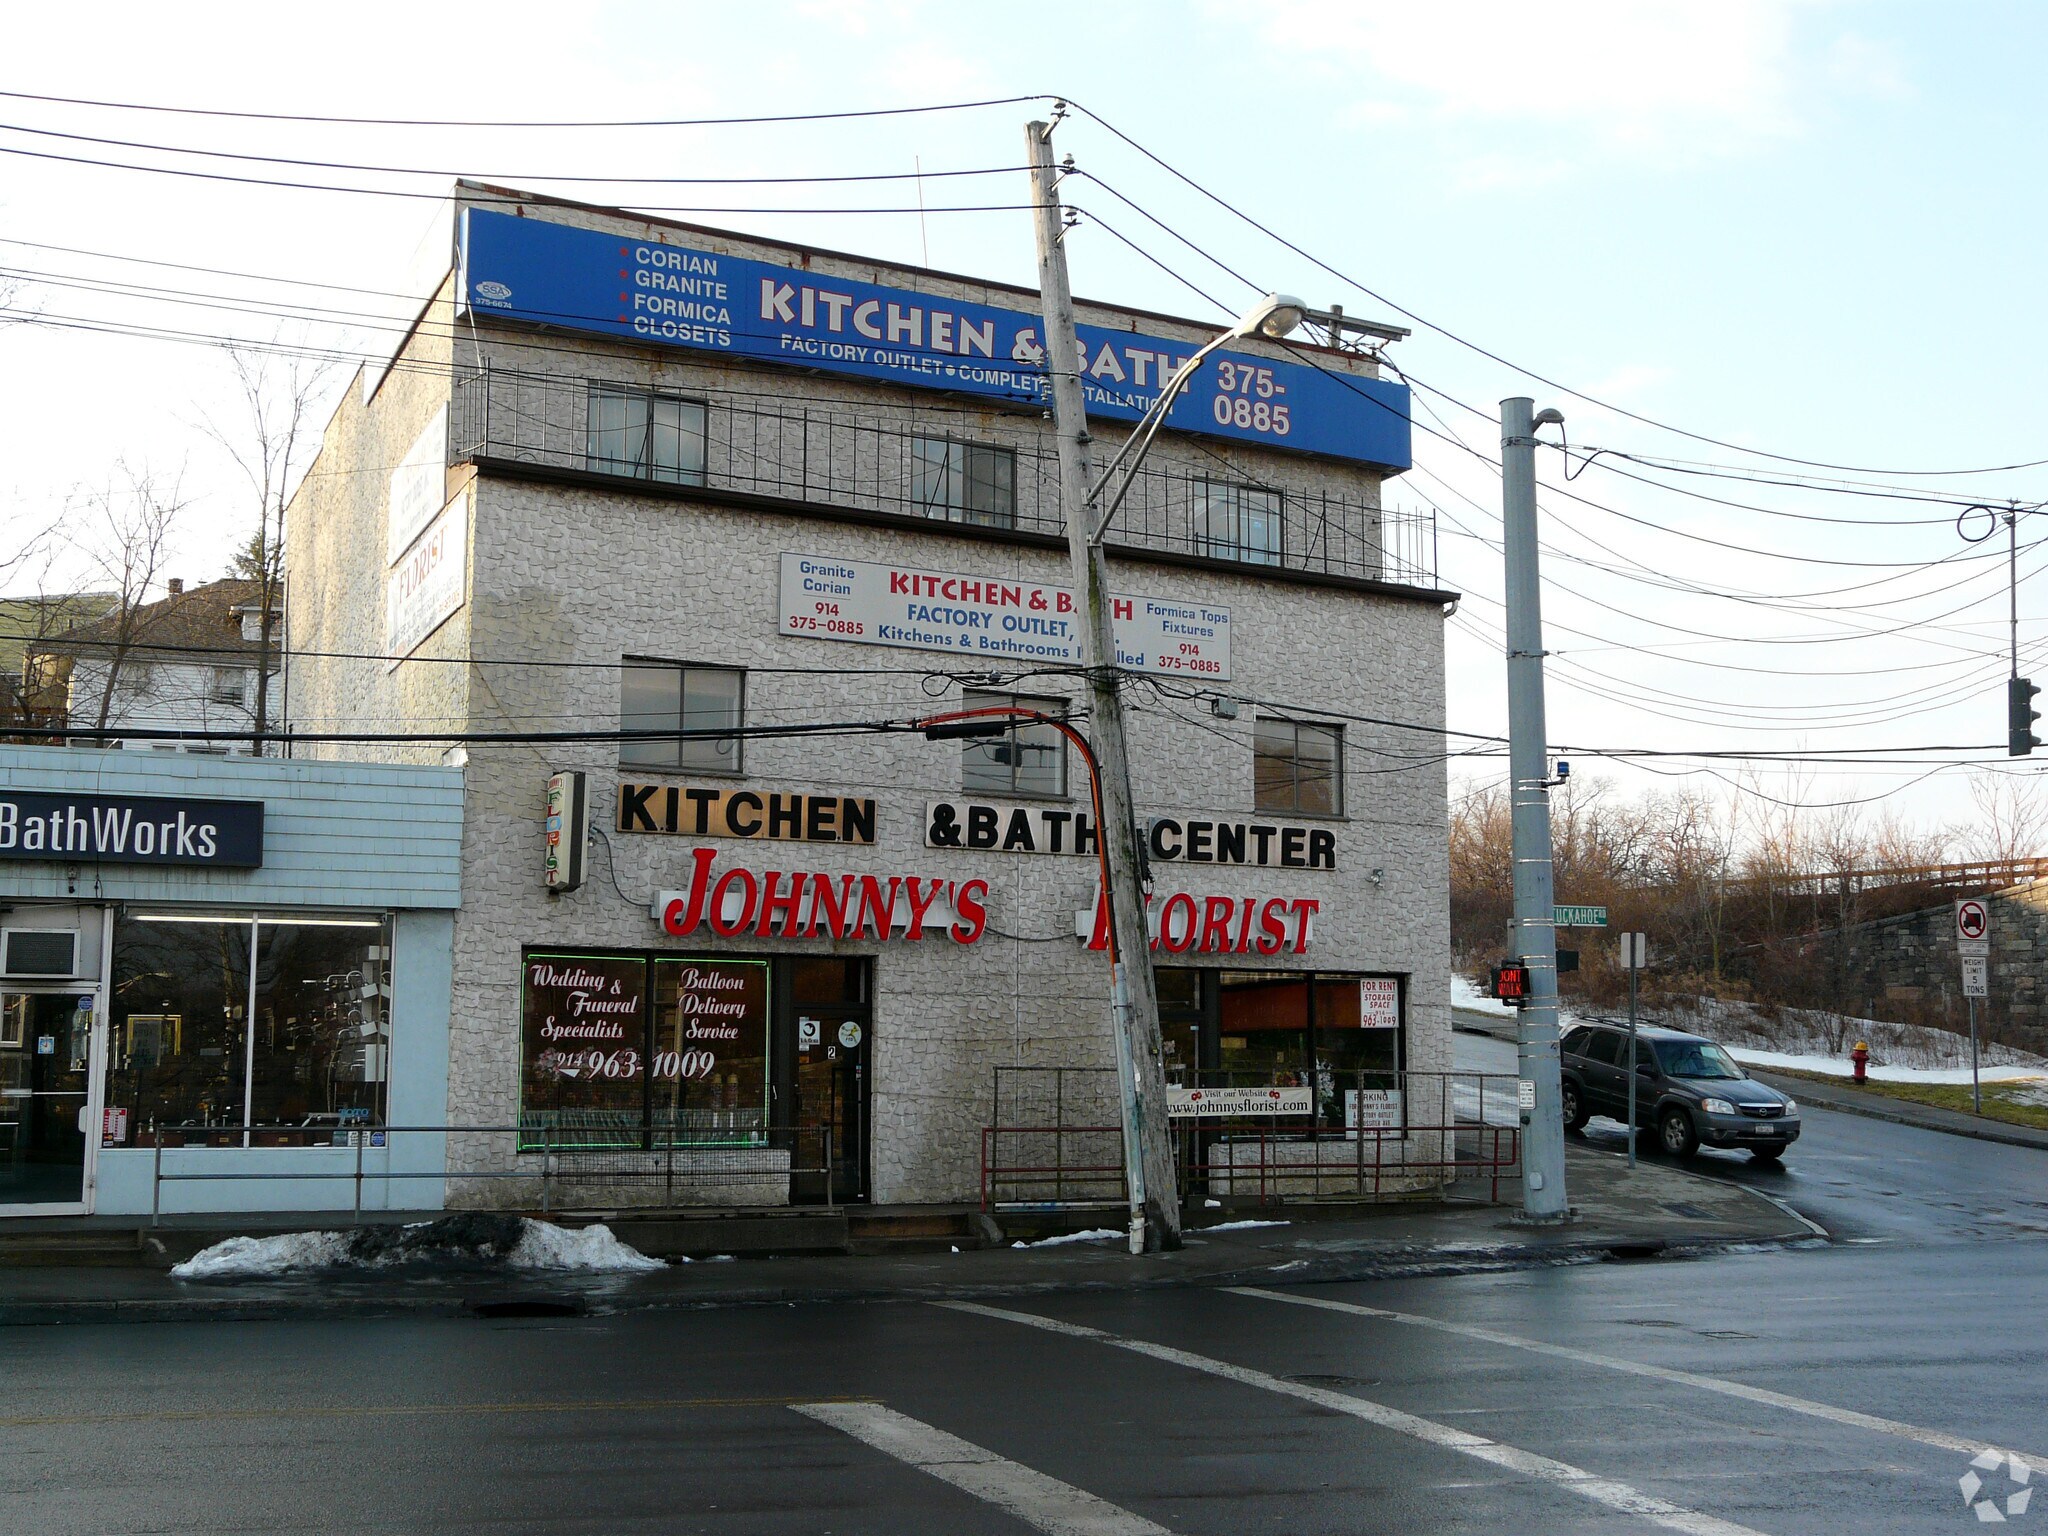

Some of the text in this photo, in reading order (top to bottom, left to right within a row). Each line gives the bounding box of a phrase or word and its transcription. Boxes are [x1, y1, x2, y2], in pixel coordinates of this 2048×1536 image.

[635, 247, 717, 276] CORIAN
[635, 269, 728, 300] GRANITE
[634, 293, 731, 325] FORMICA
[634, 315, 731, 347] CLOSETS
[760, 277, 995, 358] KITCHEN
[1011, 328, 1045, 367] &
[781, 333, 868, 362] FACTORY
[873, 350, 943, 376] OUTLET
[1217, 360, 1286, 399] 375-
[1213, 395, 1291, 436] 0885
[800, 561, 855, 579] Granite
[803, 578, 851, 595] Corian
[889, 571, 1133, 621] KITCHEN & BH
[815, 601, 840, 616] 914
[1146, 603, 1228, 624] Formica Tops
[788, 615, 864, 635] 375-0885
[907, 603, 1074, 642] FACTORY OUTLET,
[1162, 620, 1215, 637] Fixtures
[878, 624, 1144, 666] Kitchens & Bathrooms Illed
[1178, 643, 1200, 656] 914
[1158, 655, 1221, 673] 375-0885
[0, 803, 216, 857] BathWorks
[546, 790, 562, 884] FLORIST
[622, 784, 876, 843] KITCHEN
[1151, 818, 1336, 868] CENTER
[664, 847, 1319, 955] JOHNNY'S ORIST
[530, 964, 622, 995] Wedding &
[681, 968, 745, 990] Balloon
[1362, 981, 1396, 991] FOR RENT
[1966, 985, 1985, 994] TONS
[1972, 976, 1978, 984] 5
[566, 991, 638, 1017] Funeral
[678, 993, 747, 1019] Delivery
[1364, 993, 1395, 1001] STORAGE
[540, 1016, 624, 1042] Specialists
[686, 1018, 739, 1039] Service
[1363, 1014, 1396, 1027] 963-1009
[557, 1052, 583, 1068] 914
[828, 1047, 835, 1058] 2
[1204, 1089, 1267, 1098] Visit our Website
[1354, 1093, 1389, 1101] PRKING
